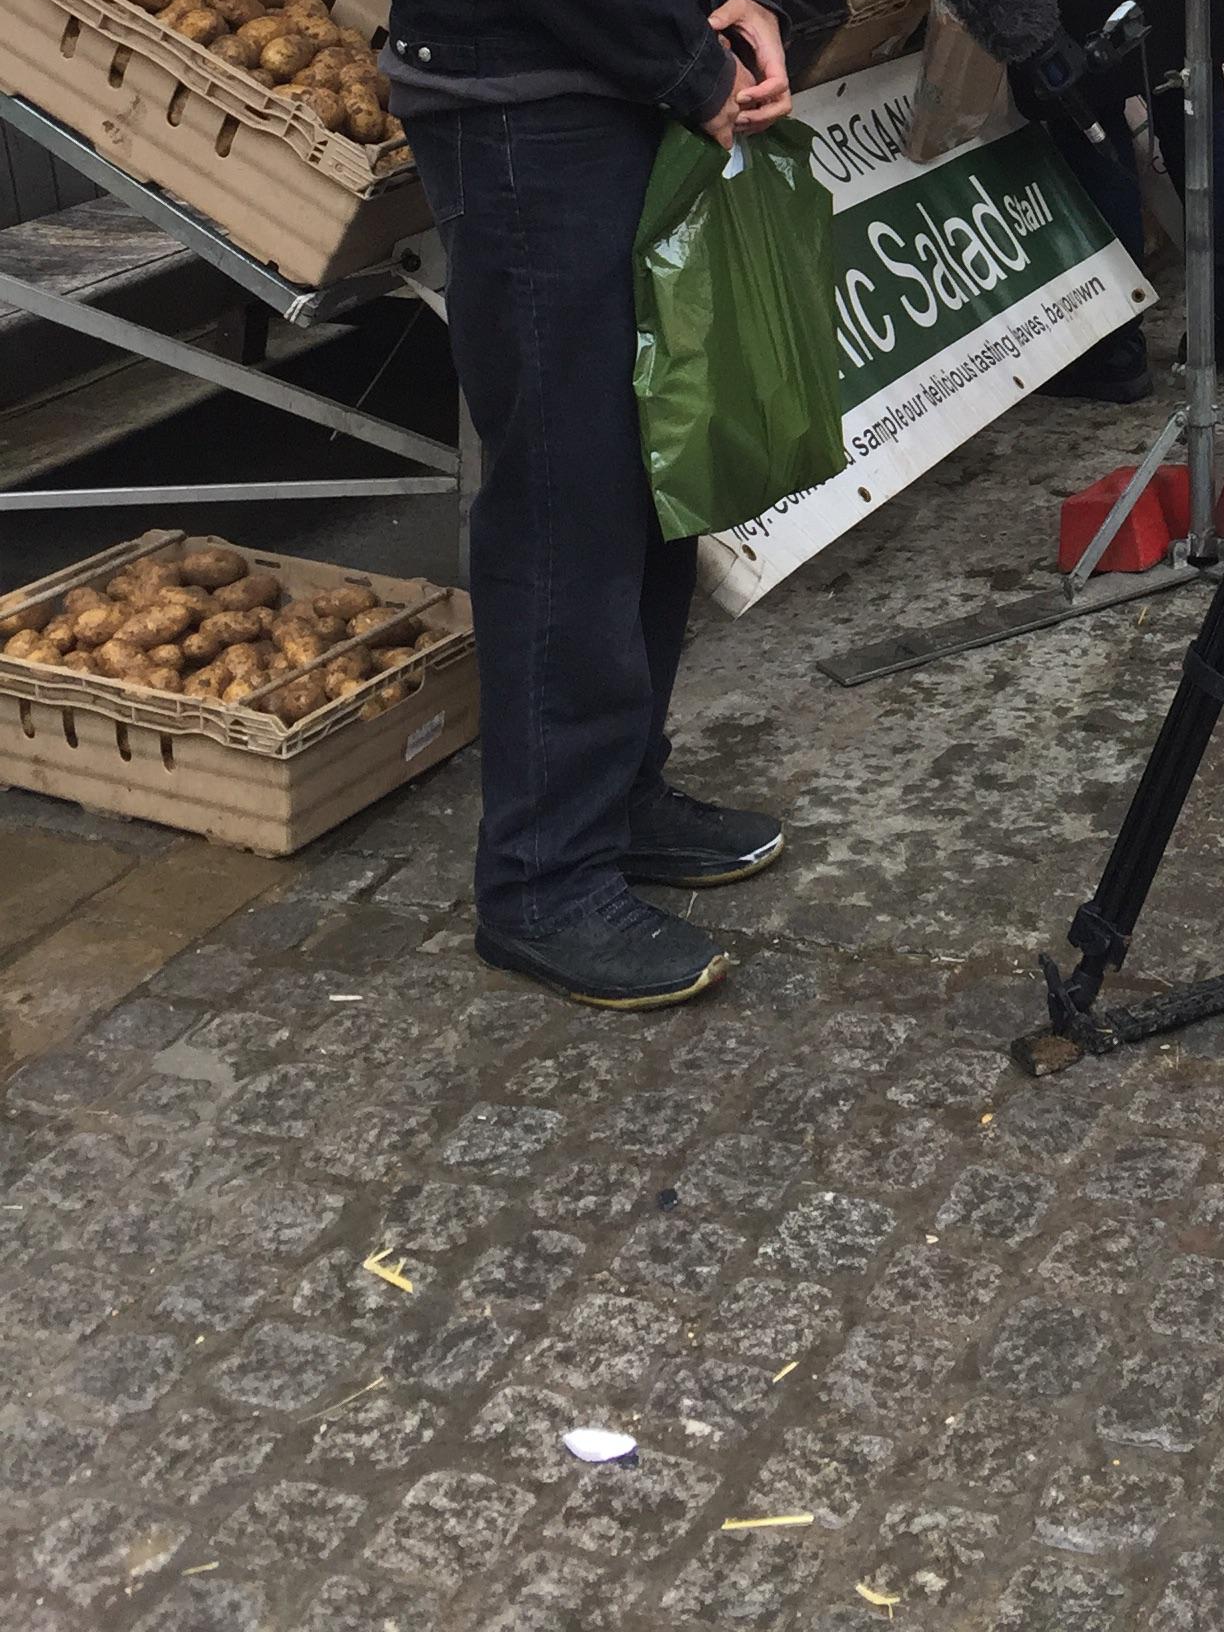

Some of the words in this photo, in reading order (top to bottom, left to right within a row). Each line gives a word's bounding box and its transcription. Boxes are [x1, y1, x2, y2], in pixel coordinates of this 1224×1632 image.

[811, 95, 911, 183] ORGAN
[868, 174, 1031, 328] Salad
[1003, 182, 1053, 237] Stall
[852, 405, 909, 457] sample
[902, 393, 928, 422] our
[920, 362, 978, 406] delicious
[967, 334, 1021, 373] tasting
